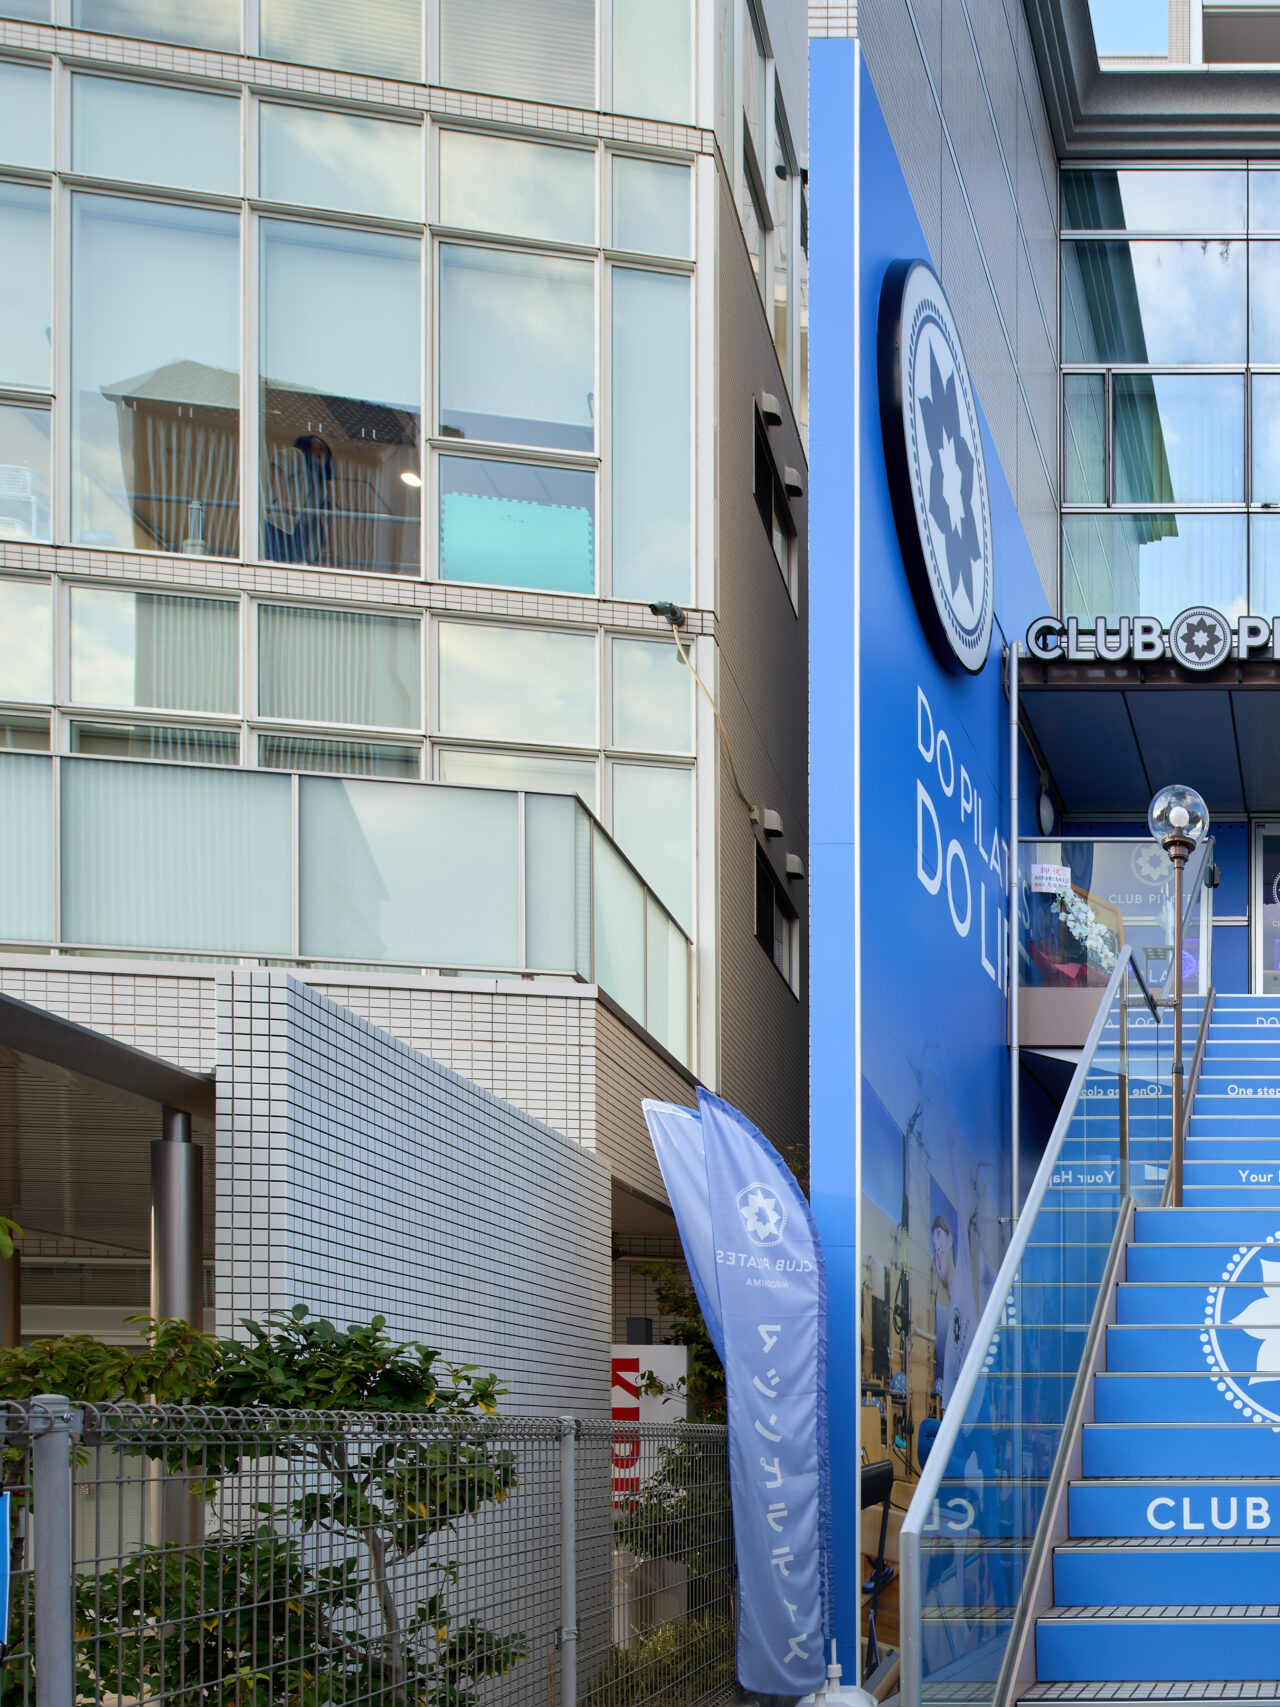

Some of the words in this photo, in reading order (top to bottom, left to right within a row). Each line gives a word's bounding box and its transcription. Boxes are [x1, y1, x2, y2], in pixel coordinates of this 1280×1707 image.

[1026, 616, 1165, 661] CLUB
[917, 684, 955, 798] DO
[917, 777, 972, 938] DO
[1108, 894, 1143, 904] CLUB
[1227, 1084, 1254, 1096] One
[1238, 1169, 1273, 1183] Your
[1146, 1496, 1271, 1531] CLUB
